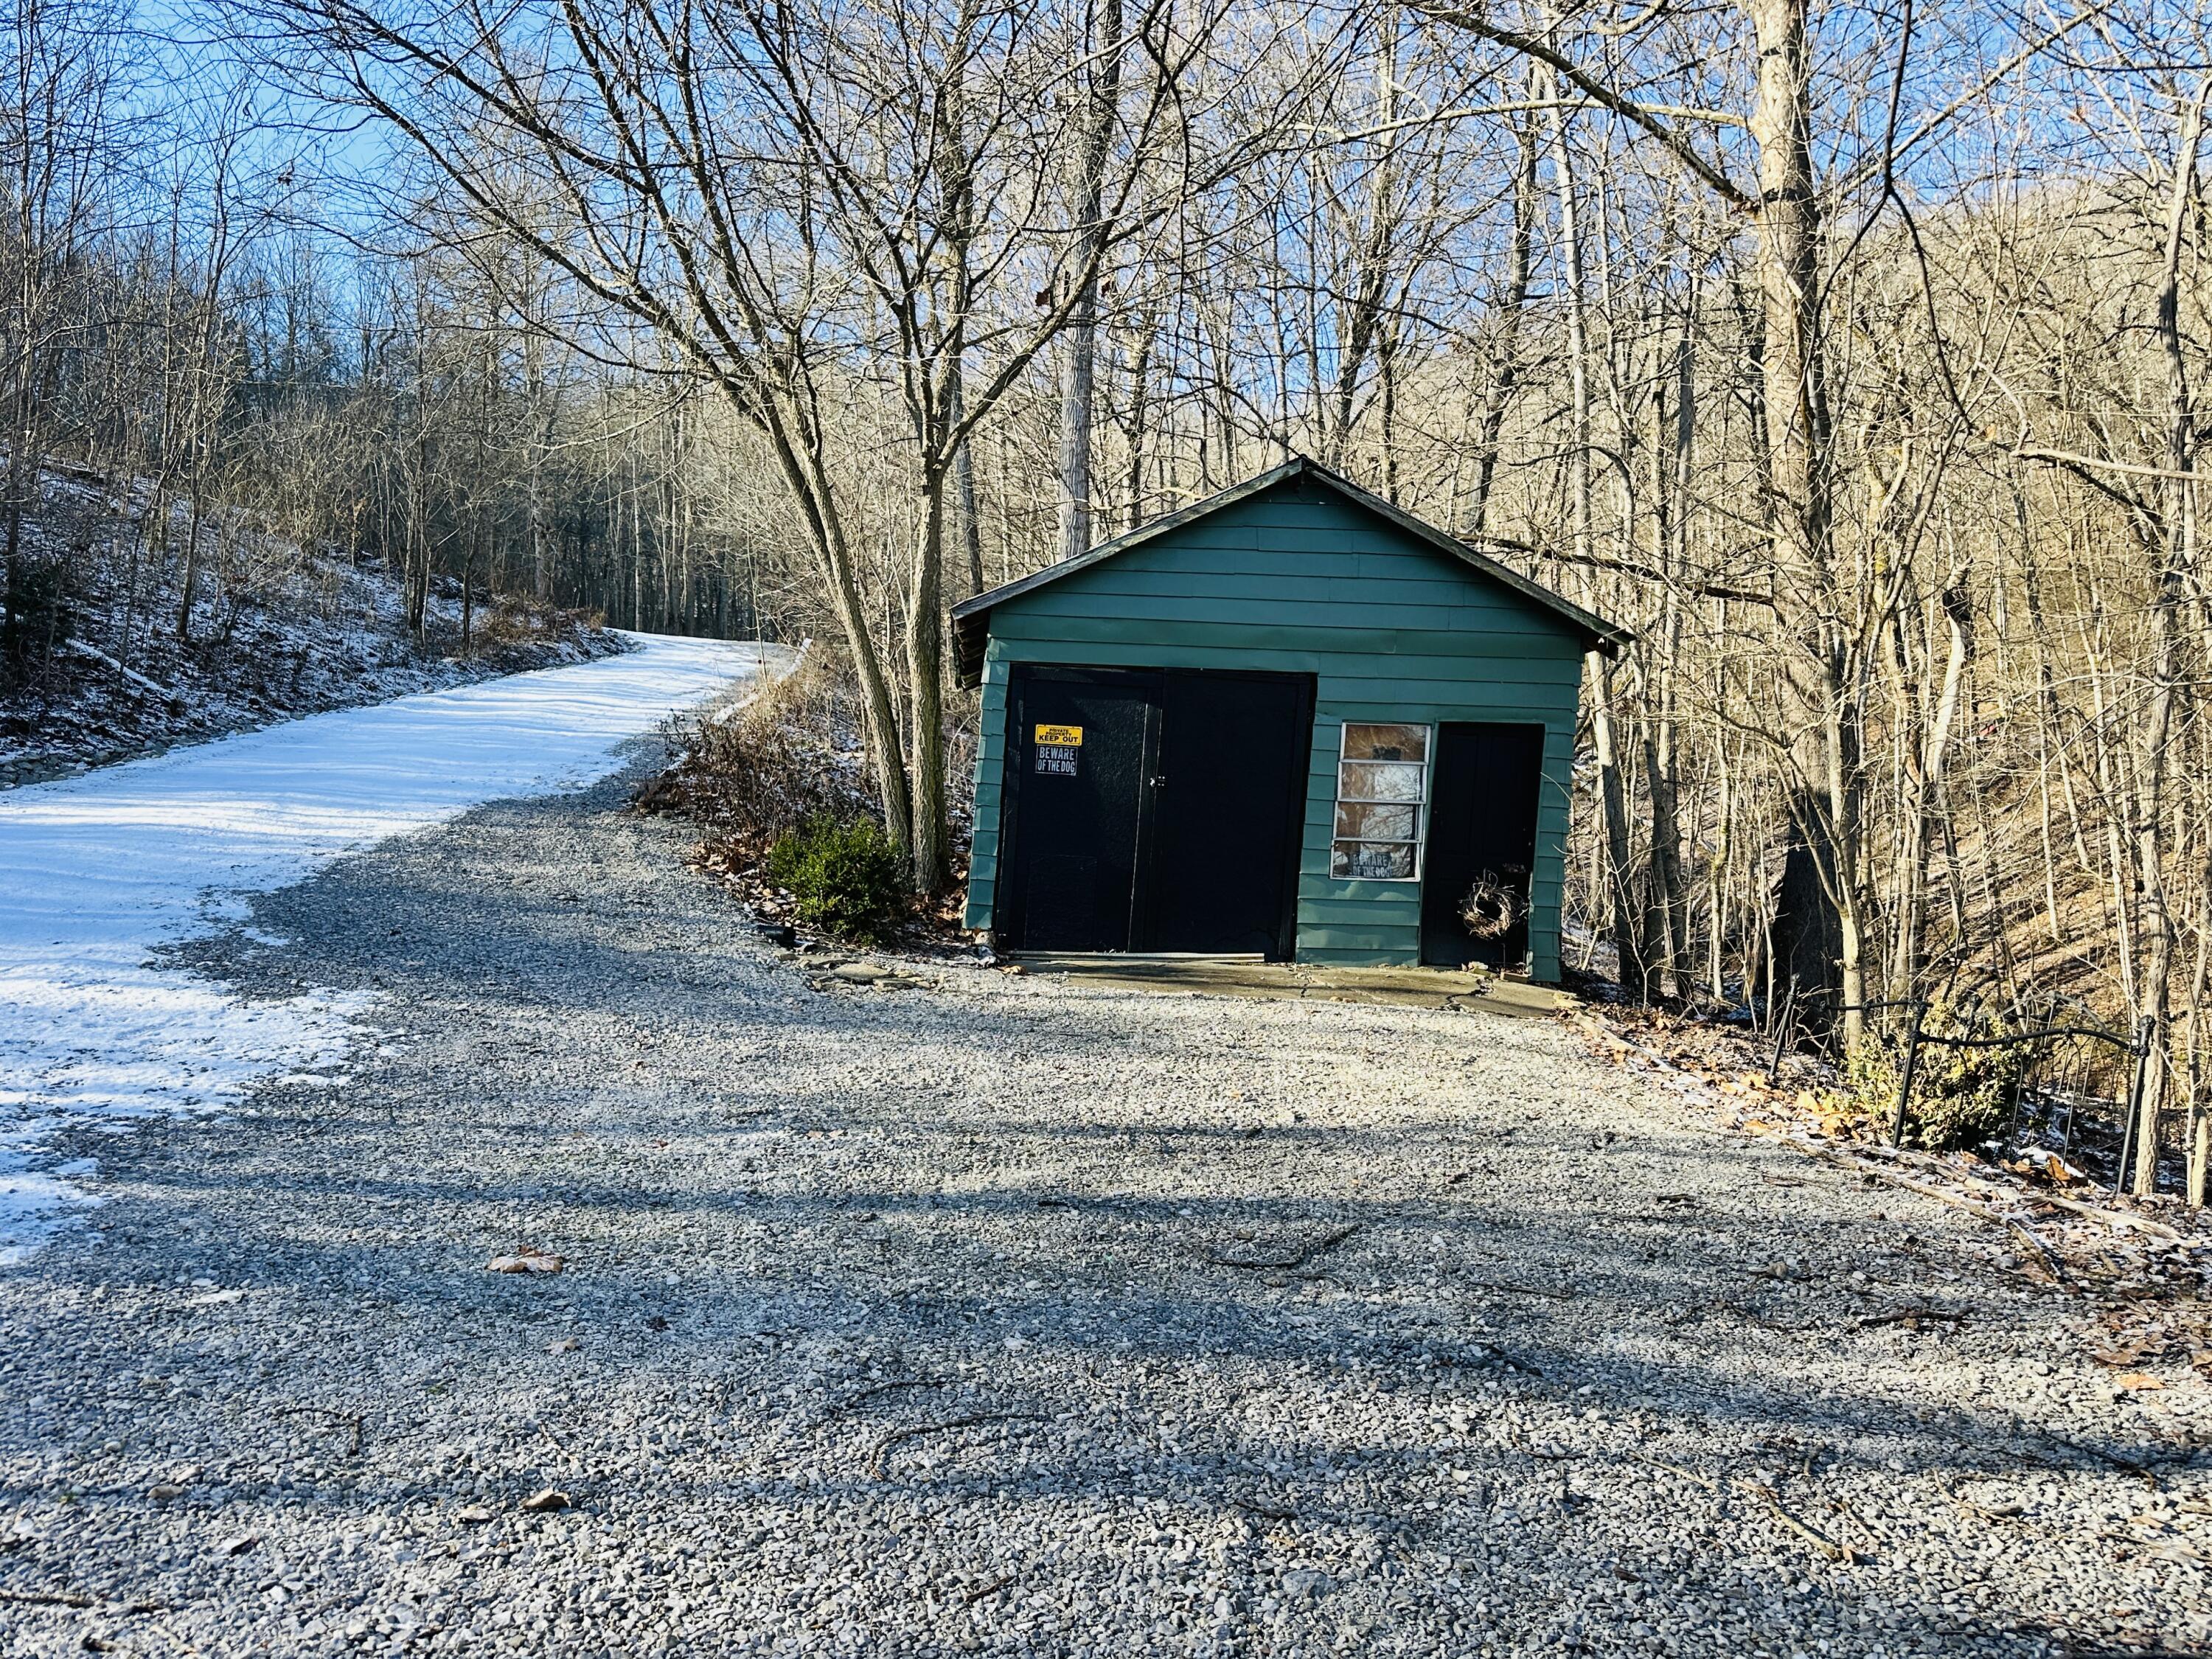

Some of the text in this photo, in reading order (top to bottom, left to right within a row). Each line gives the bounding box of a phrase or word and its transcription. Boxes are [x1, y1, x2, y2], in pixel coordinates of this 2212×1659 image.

[1039, 747, 1074, 760] BEWARE
[1037, 759, 1075, 773] OF THE DOG
[1353, 866, 1390, 877] OF THE DOG
